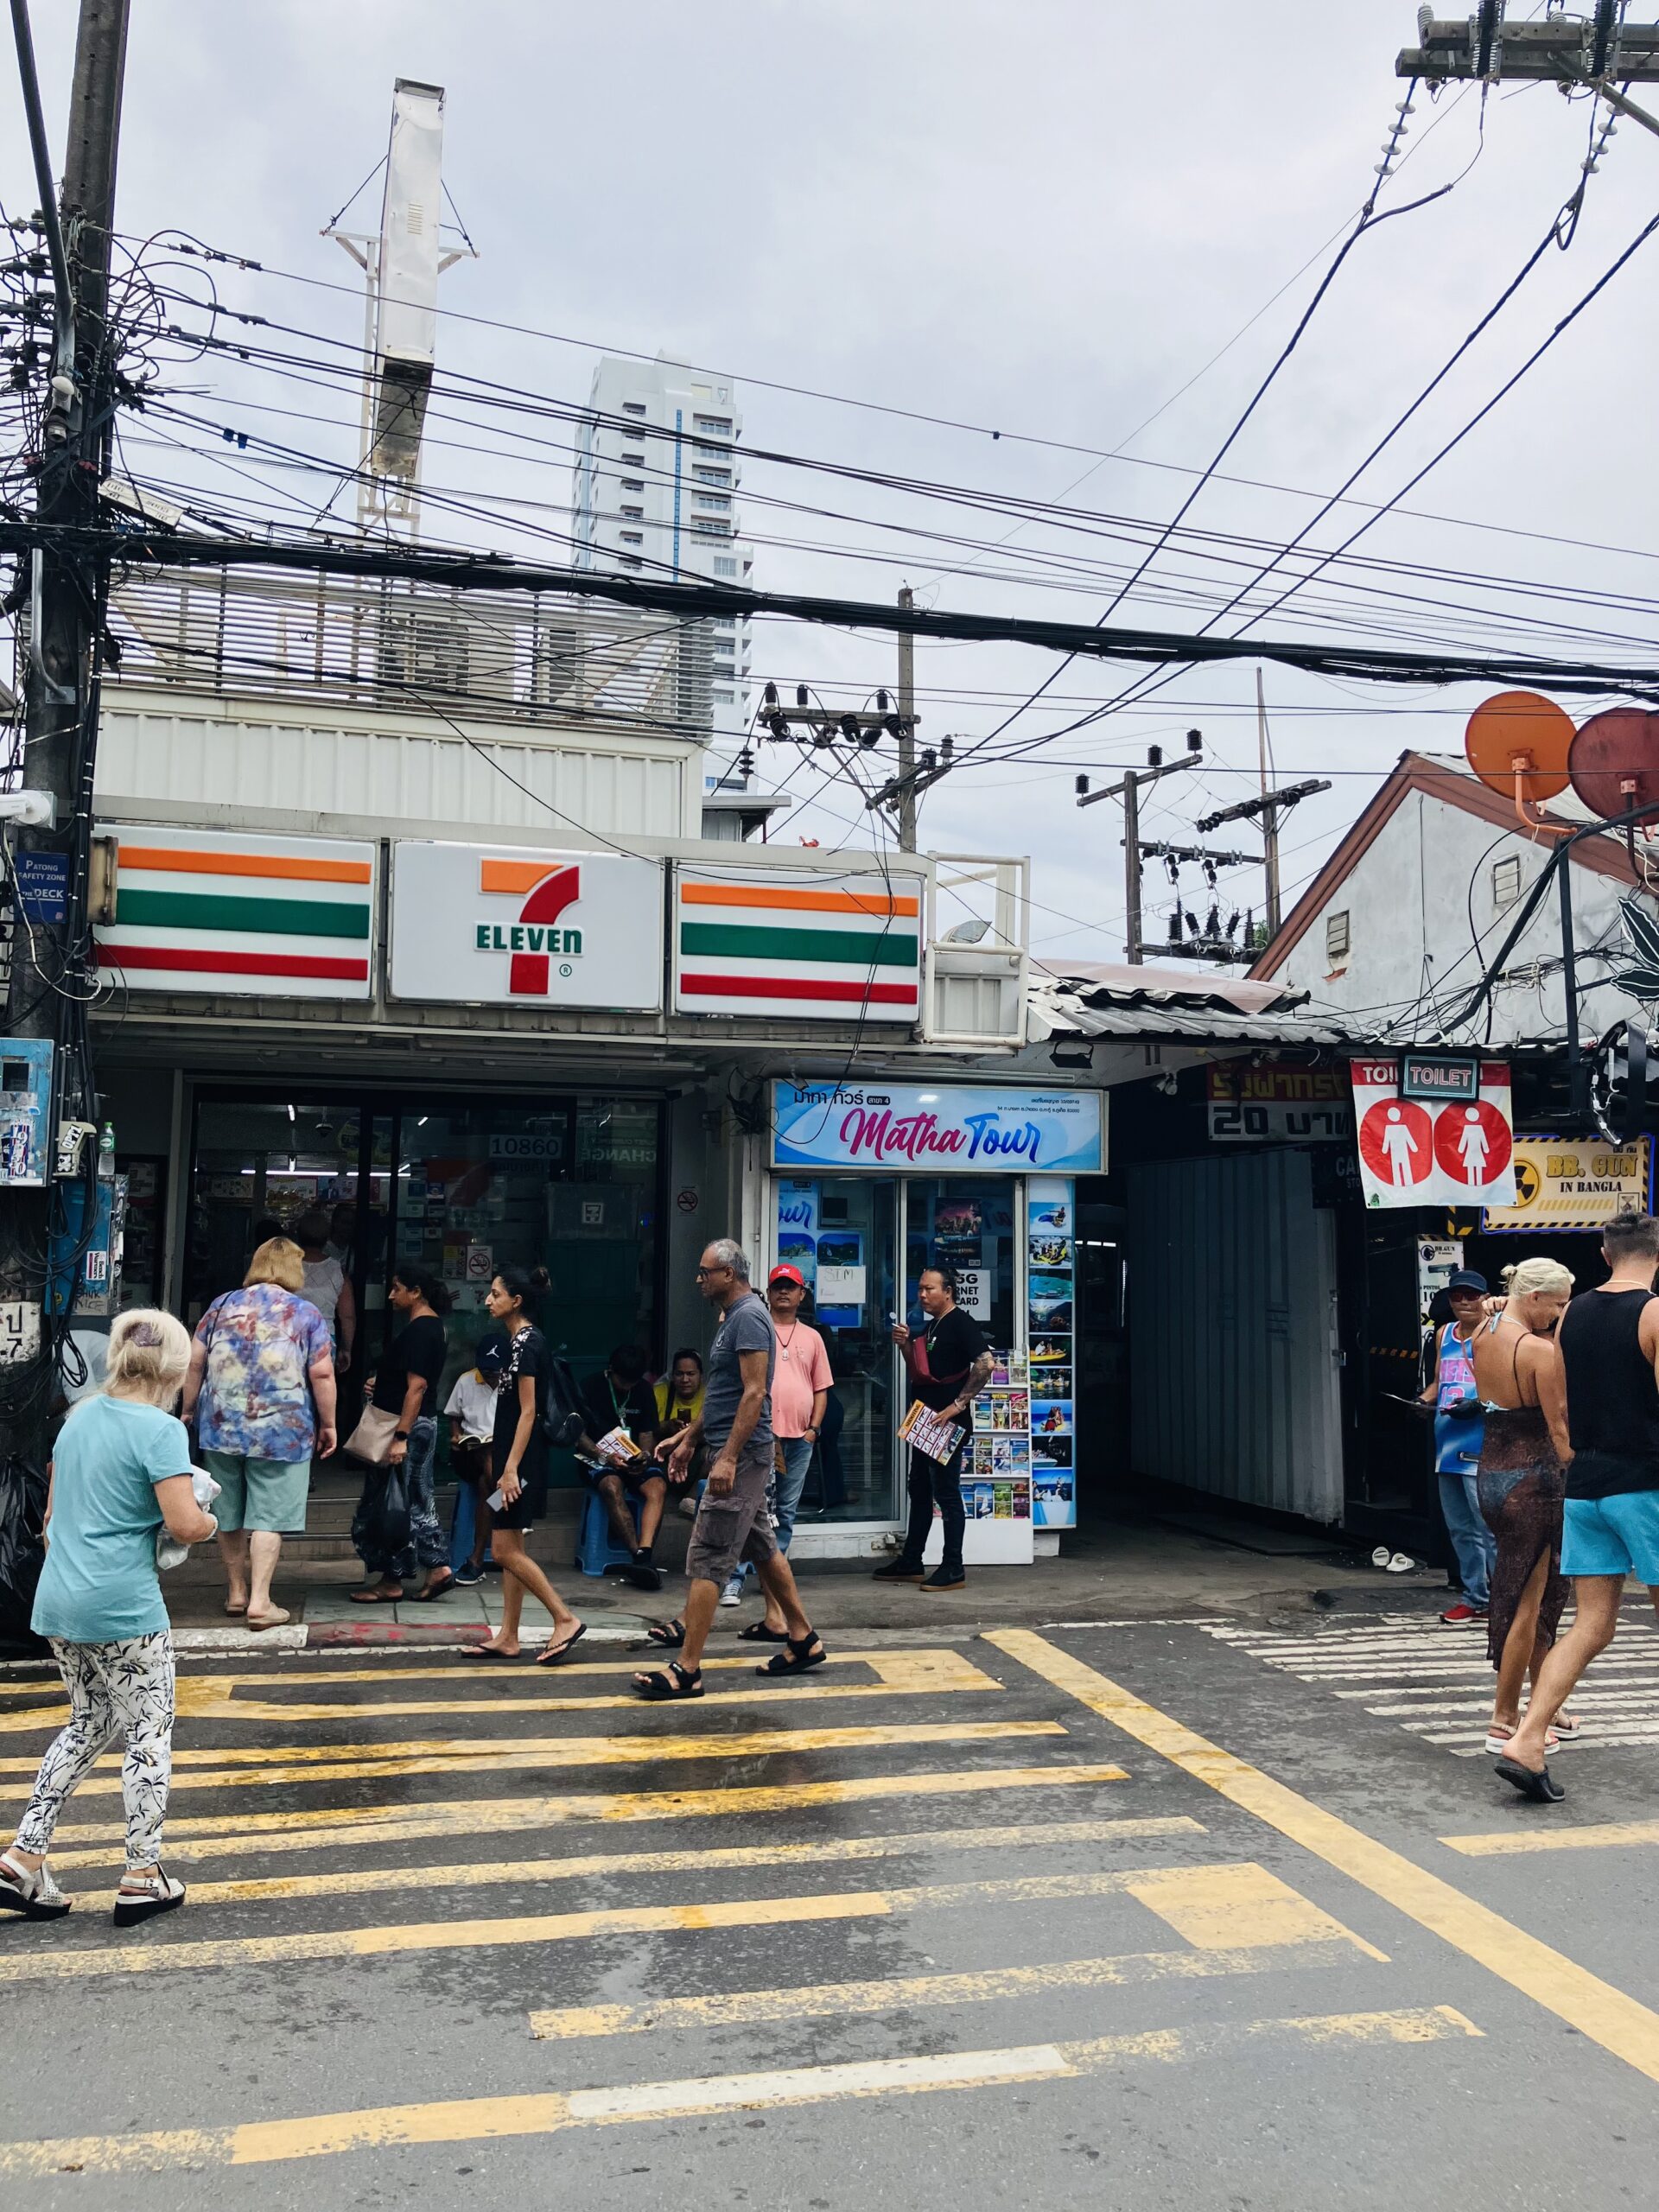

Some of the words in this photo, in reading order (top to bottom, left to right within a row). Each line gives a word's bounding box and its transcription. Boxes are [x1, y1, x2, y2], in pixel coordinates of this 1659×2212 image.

[26, 860, 58, 871] PATONG
[35, 888, 64, 898] DECK
[1410, 1066, 1471, 1087] TOILET
[833, 1090, 863, 1105] ทัวร์
[1214, 1106, 1268, 1135] 20
[839, 1108, 967, 1161] Matha
[964, 1113, 1040, 1163] Tour
[492, 1138, 559, 1155] 10860
[1336, 1155, 1360, 1176] CA
[1547, 1155, 1586, 1177] BB.
[1592, 1155, 1638, 1177] GUN
[1560, 1181, 1573, 1192] IN
[1577, 1181, 1622, 1192] BANGLA
